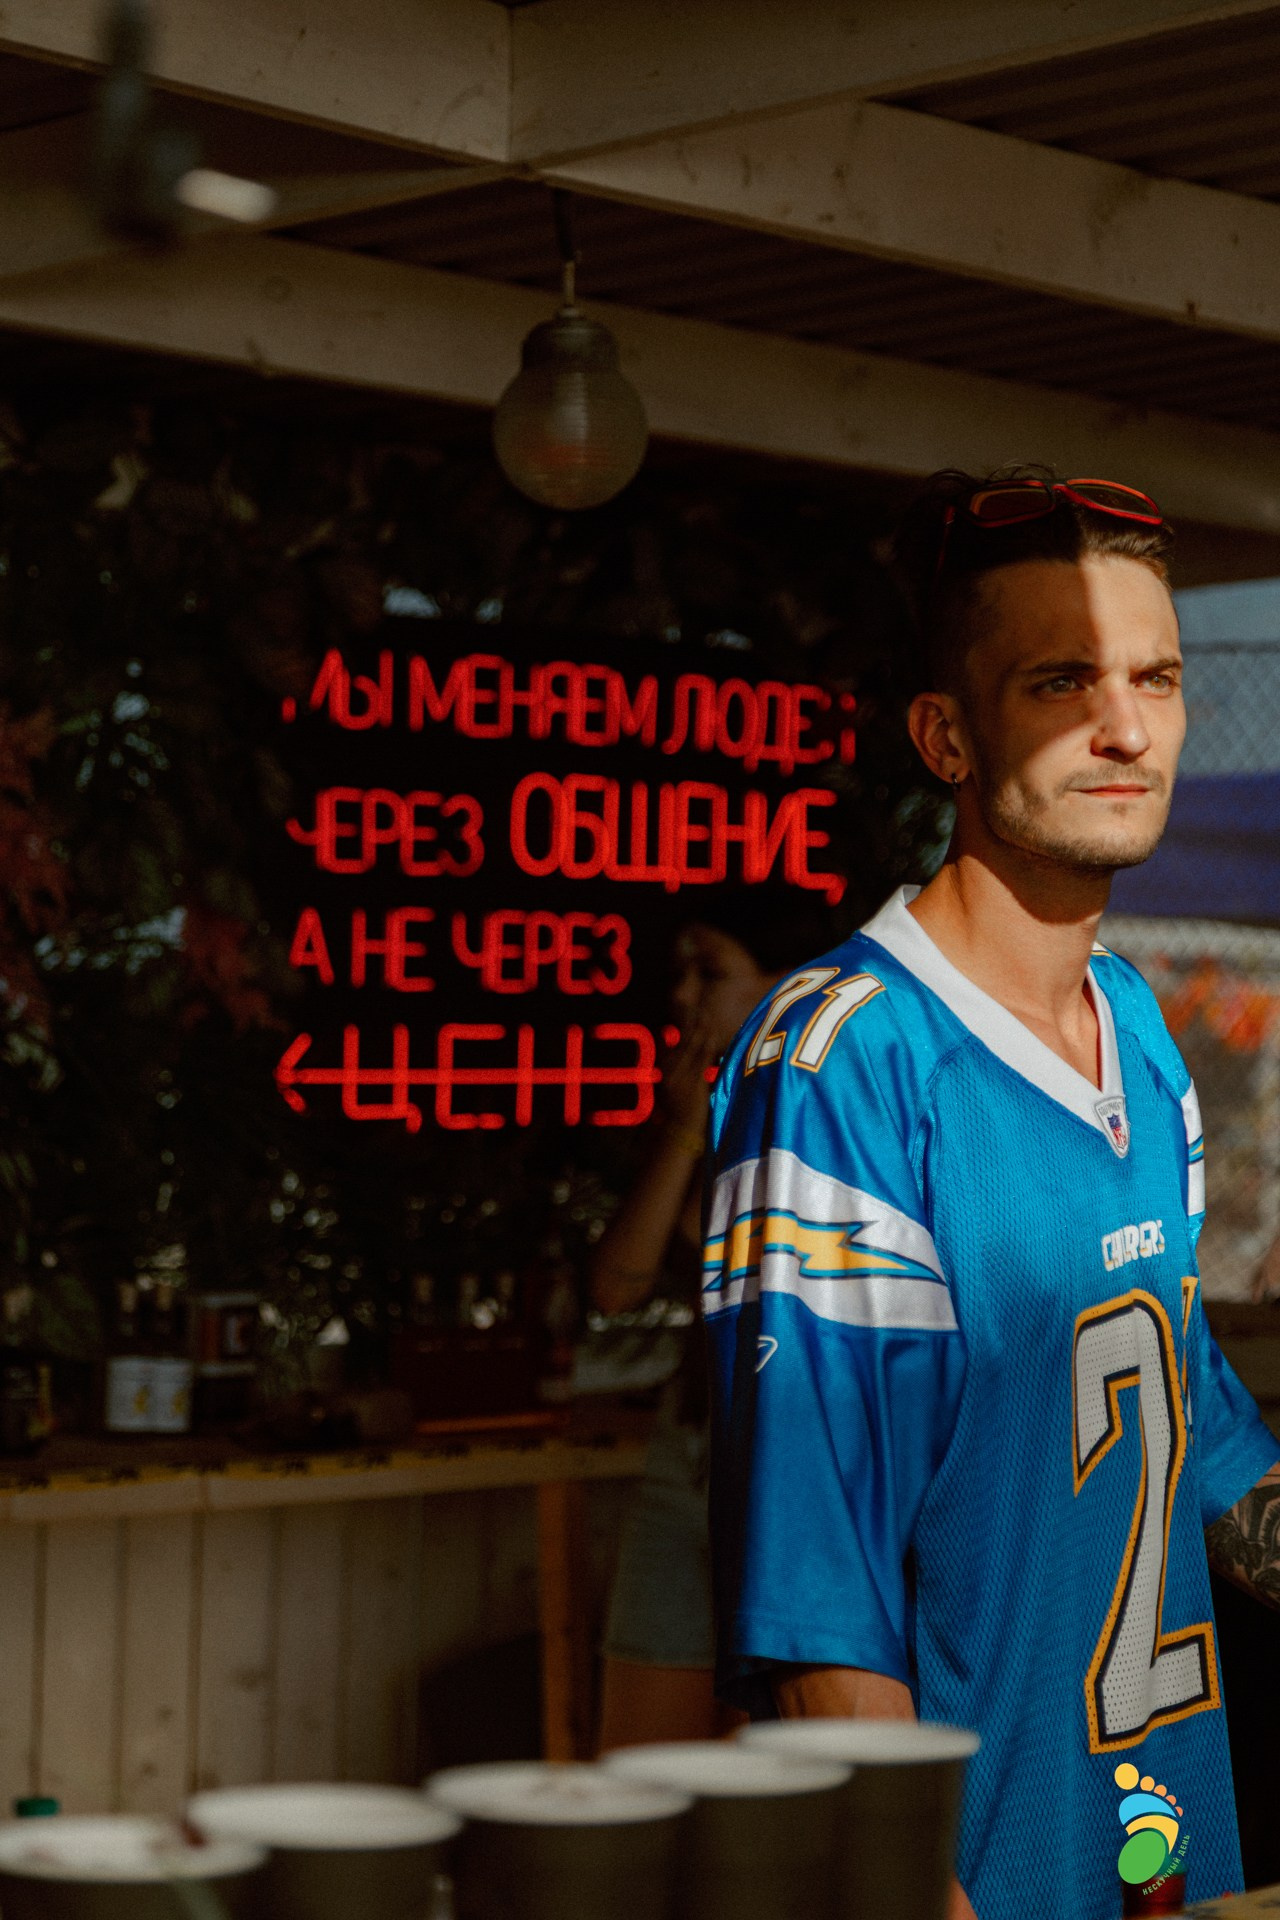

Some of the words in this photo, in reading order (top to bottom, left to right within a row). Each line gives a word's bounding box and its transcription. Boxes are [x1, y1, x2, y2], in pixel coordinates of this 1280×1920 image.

[409, 653, 659, 747] МЕНЯЕМ
[290, 907, 335, 985] А
[351, 907, 436, 992] НЕ
[452, 909, 632, 995] ЧЕРЕЗ
[744, 966, 887, 1077] 21
